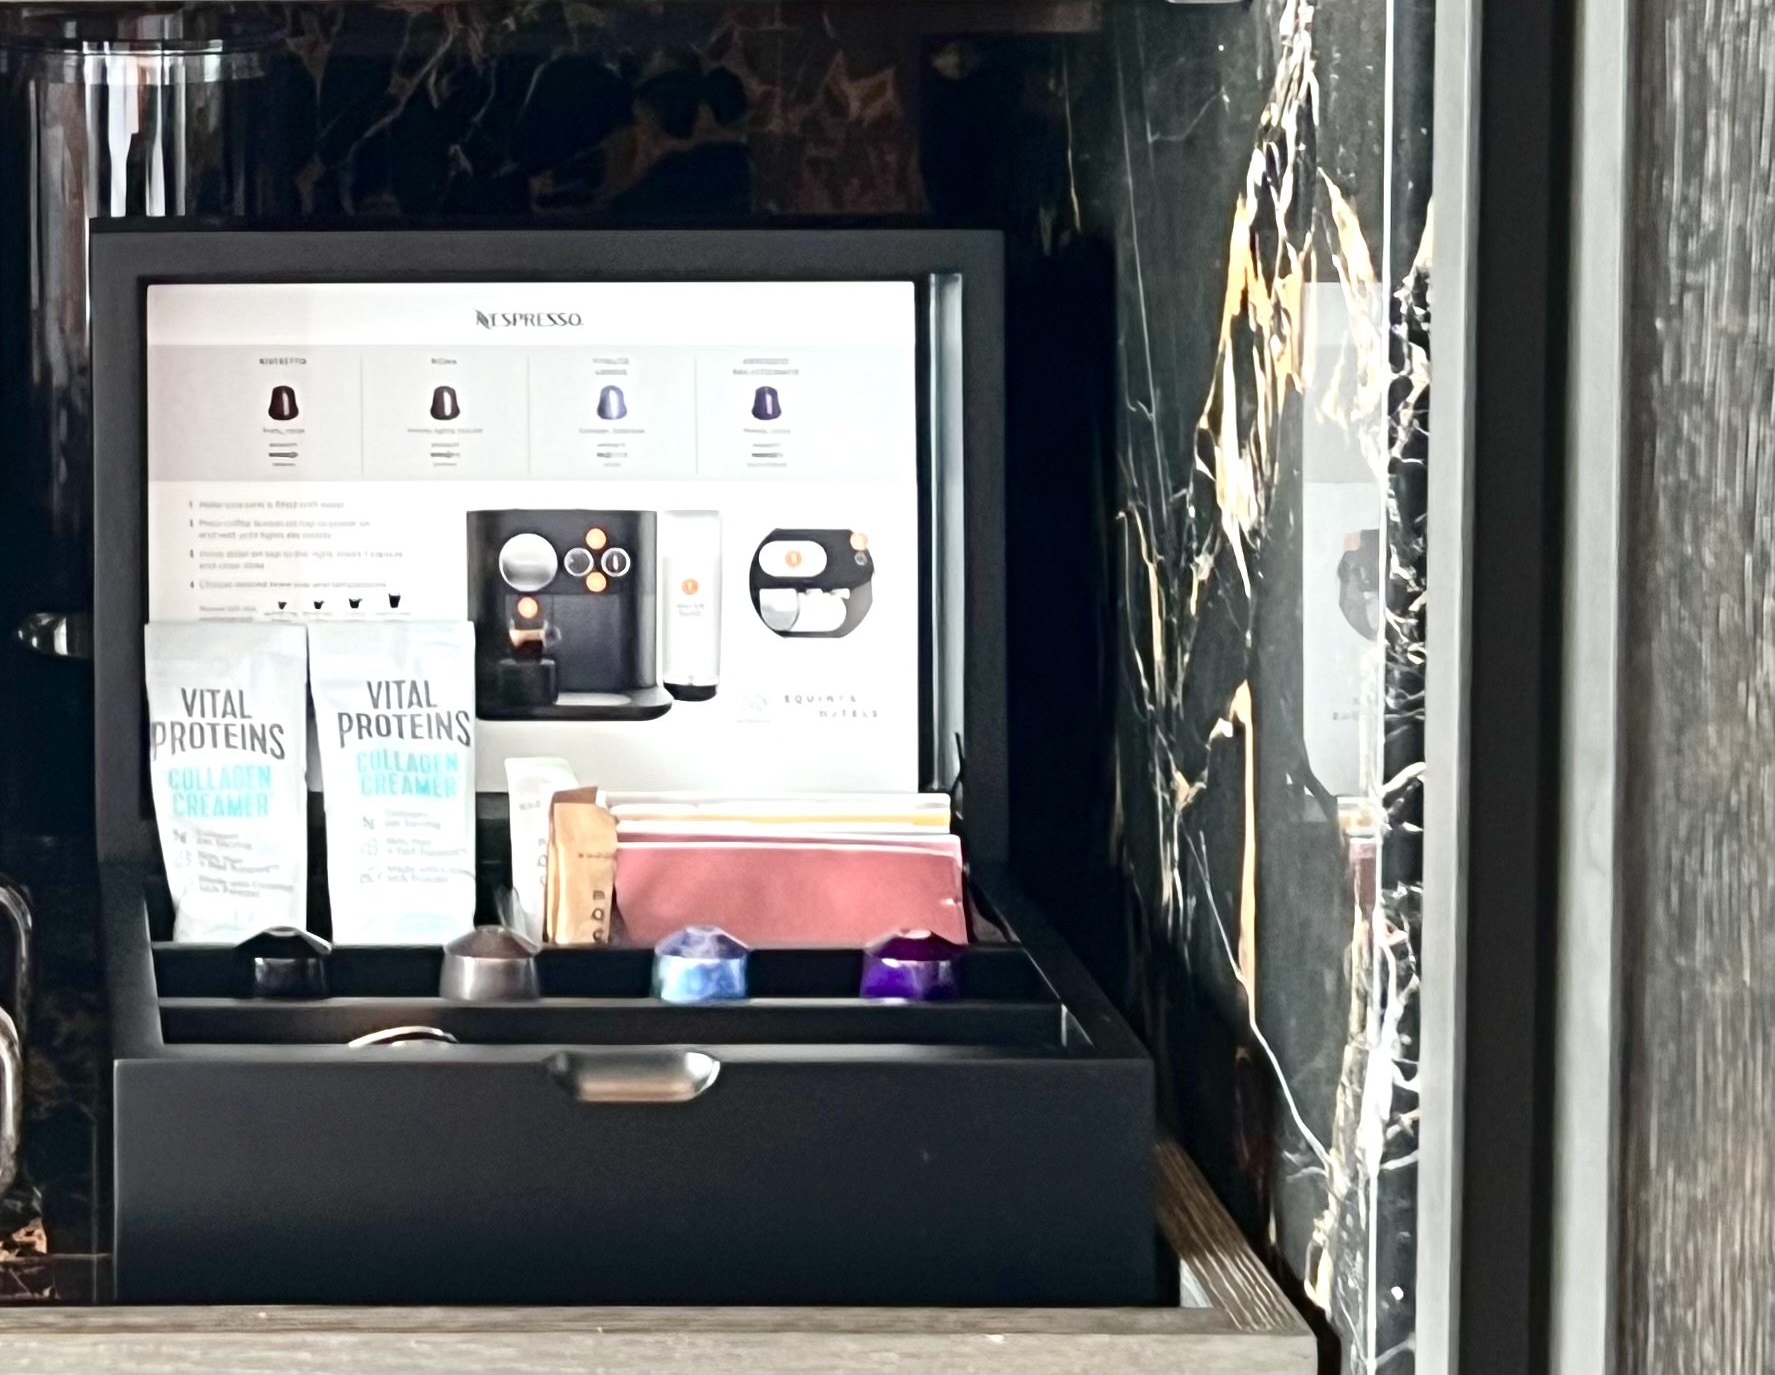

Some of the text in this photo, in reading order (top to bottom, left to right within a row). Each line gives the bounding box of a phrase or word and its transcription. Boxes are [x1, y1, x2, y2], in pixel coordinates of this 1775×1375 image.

[474, 308, 585, 329] NESPRESSO
[181, 687, 253, 719] VITAL
[367, 679, 438, 710] VITAL
[150, 721, 285, 762] PROTEINS
[337, 710, 471, 749] PROTEINS
[356, 749, 459, 774] COLLAGEN
[168, 765, 272, 791] COLLAGEN
[360, 774, 456, 799] CREAMER
[172, 792, 269, 818] CREAMER
